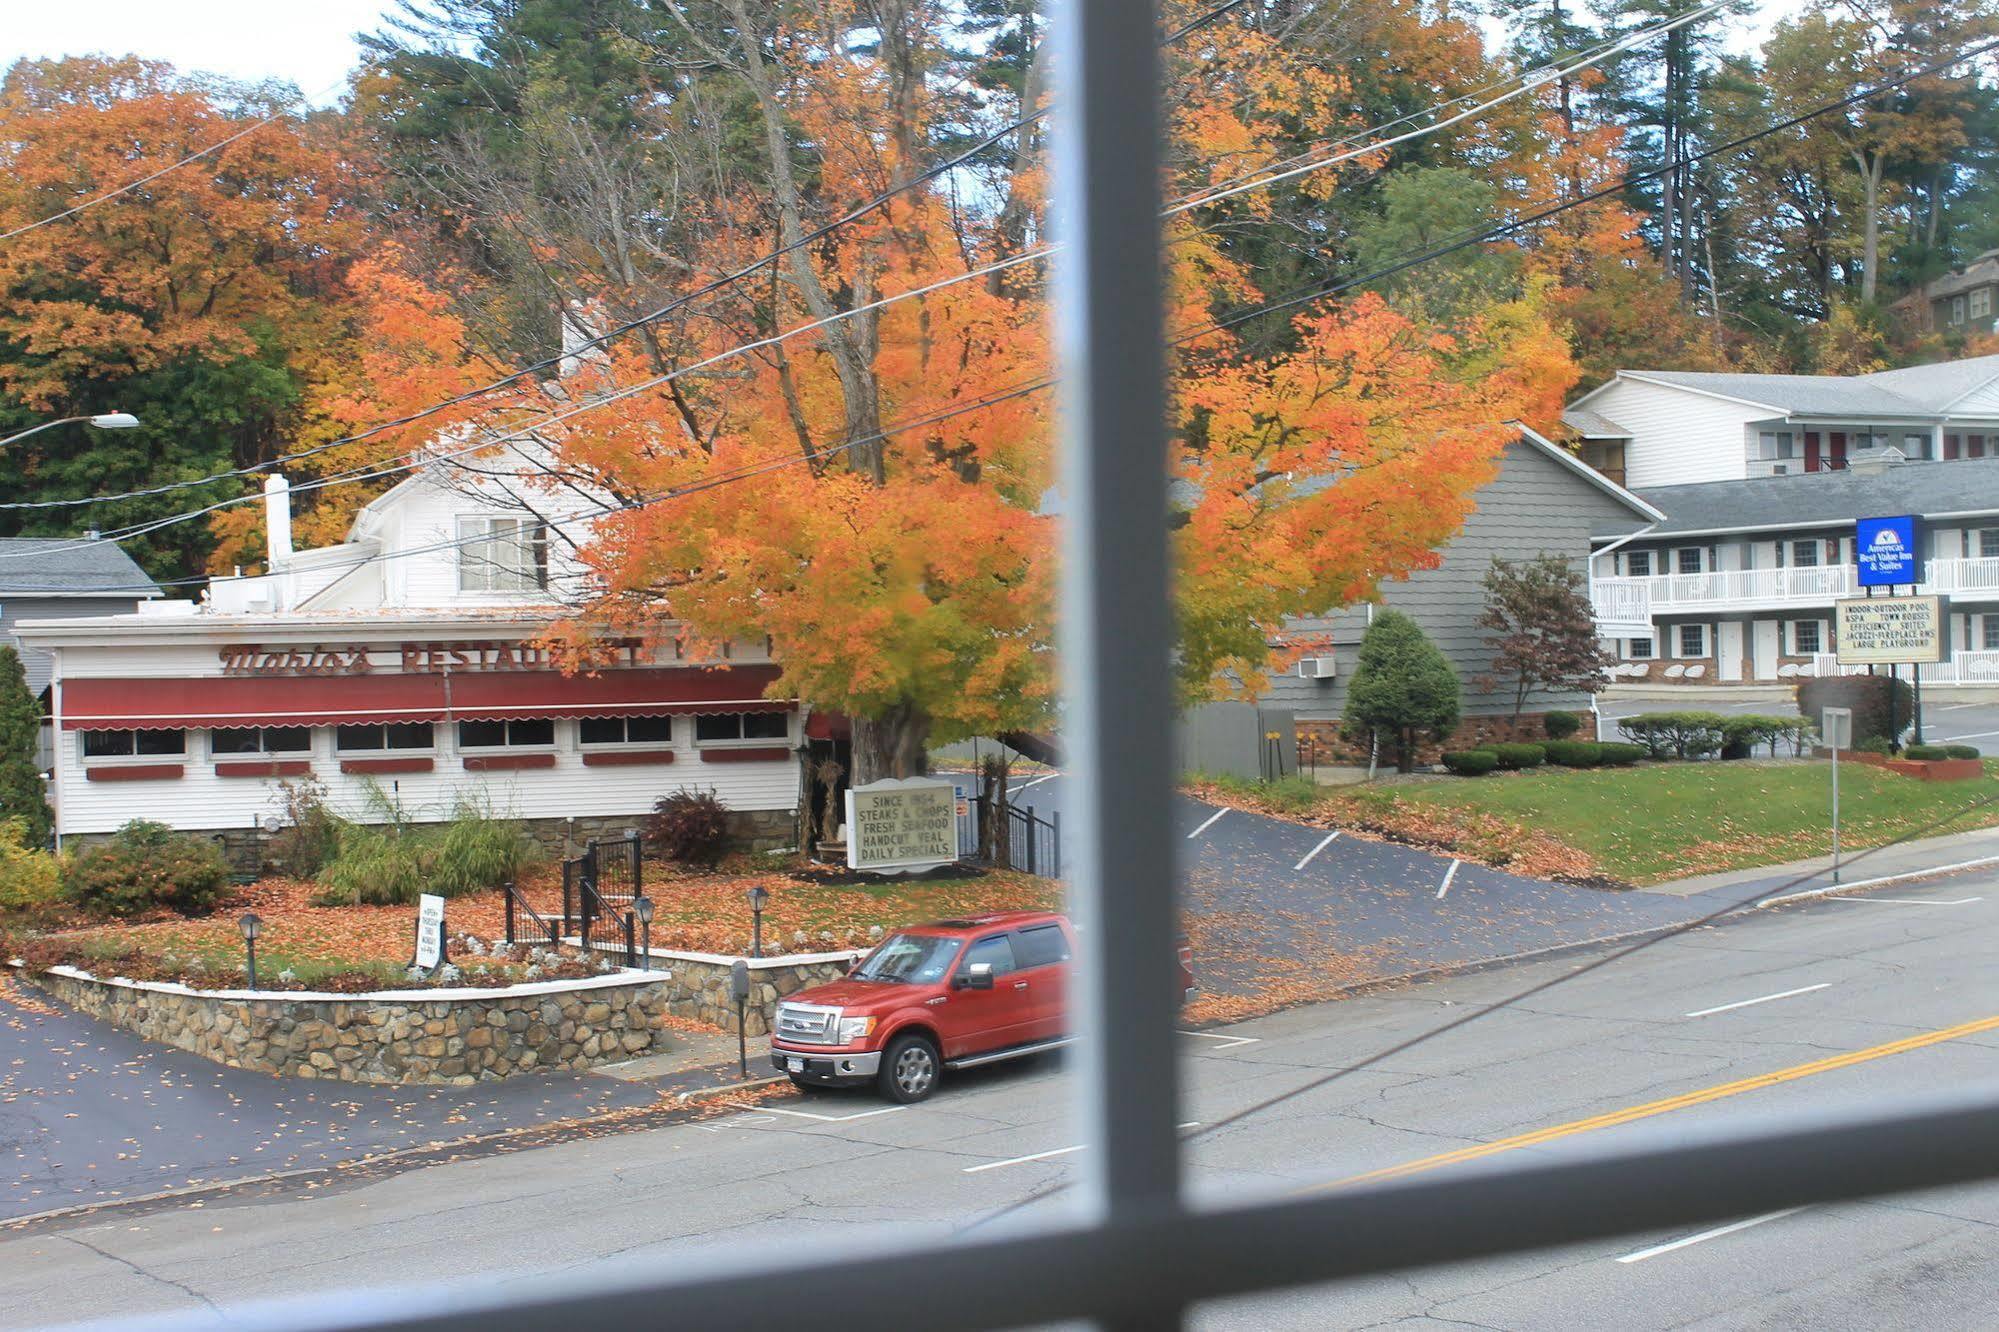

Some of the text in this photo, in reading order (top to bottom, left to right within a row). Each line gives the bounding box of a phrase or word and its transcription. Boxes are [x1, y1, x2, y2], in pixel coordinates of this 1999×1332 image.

[1867, 544, 1904, 553] Americas
[1860, 551, 1912, 562] Best Value Inn
[1870, 561, 1902, 571] & Suites
[1910, 603, 1930, 611] POOL
[1850, 621, 1926, 631] EFFICIENCY SUITES
[1853, 639, 1929, 648] LARGE PLAYGROUND
[219, 637, 643, 675] Mario's RESTAUT
[872, 795, 902, 808] SINCE
[860, 808, 899, 821] STEAKS
[864, 819, 949, 834] FRESH SEAFOOD
[863, 831, 944, 847] HANDCUT VEAL
[862, 843, 950, 859] DAILY SPECIALS
